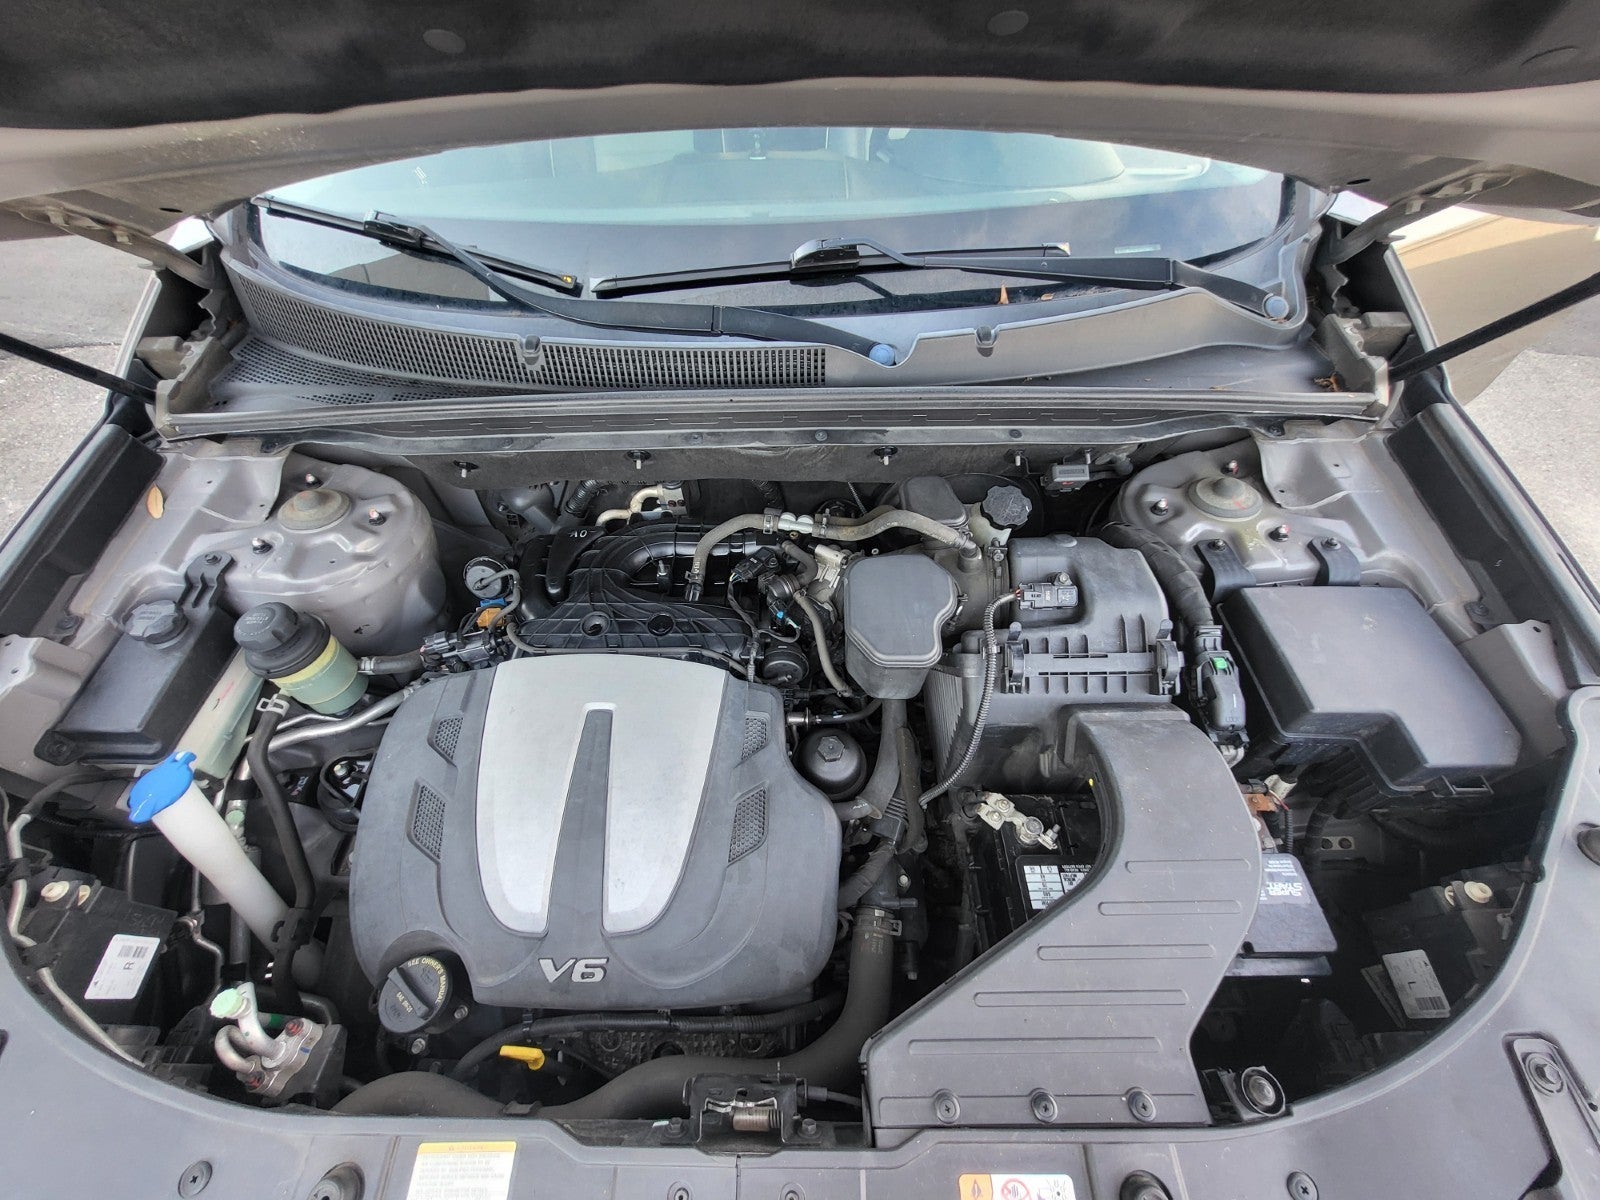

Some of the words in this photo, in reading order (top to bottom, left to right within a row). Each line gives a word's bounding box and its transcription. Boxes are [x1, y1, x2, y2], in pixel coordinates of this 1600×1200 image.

[1265, 882, 1303, 891] START
[1268, 889, 1302, 897] SUPER
[538, 957, 609, 983] V6
[407, 957, 420, 967] SEE
[421, 957, 444, 975] OWNER'S
[434, 974, 447, 1004] MANUAL
